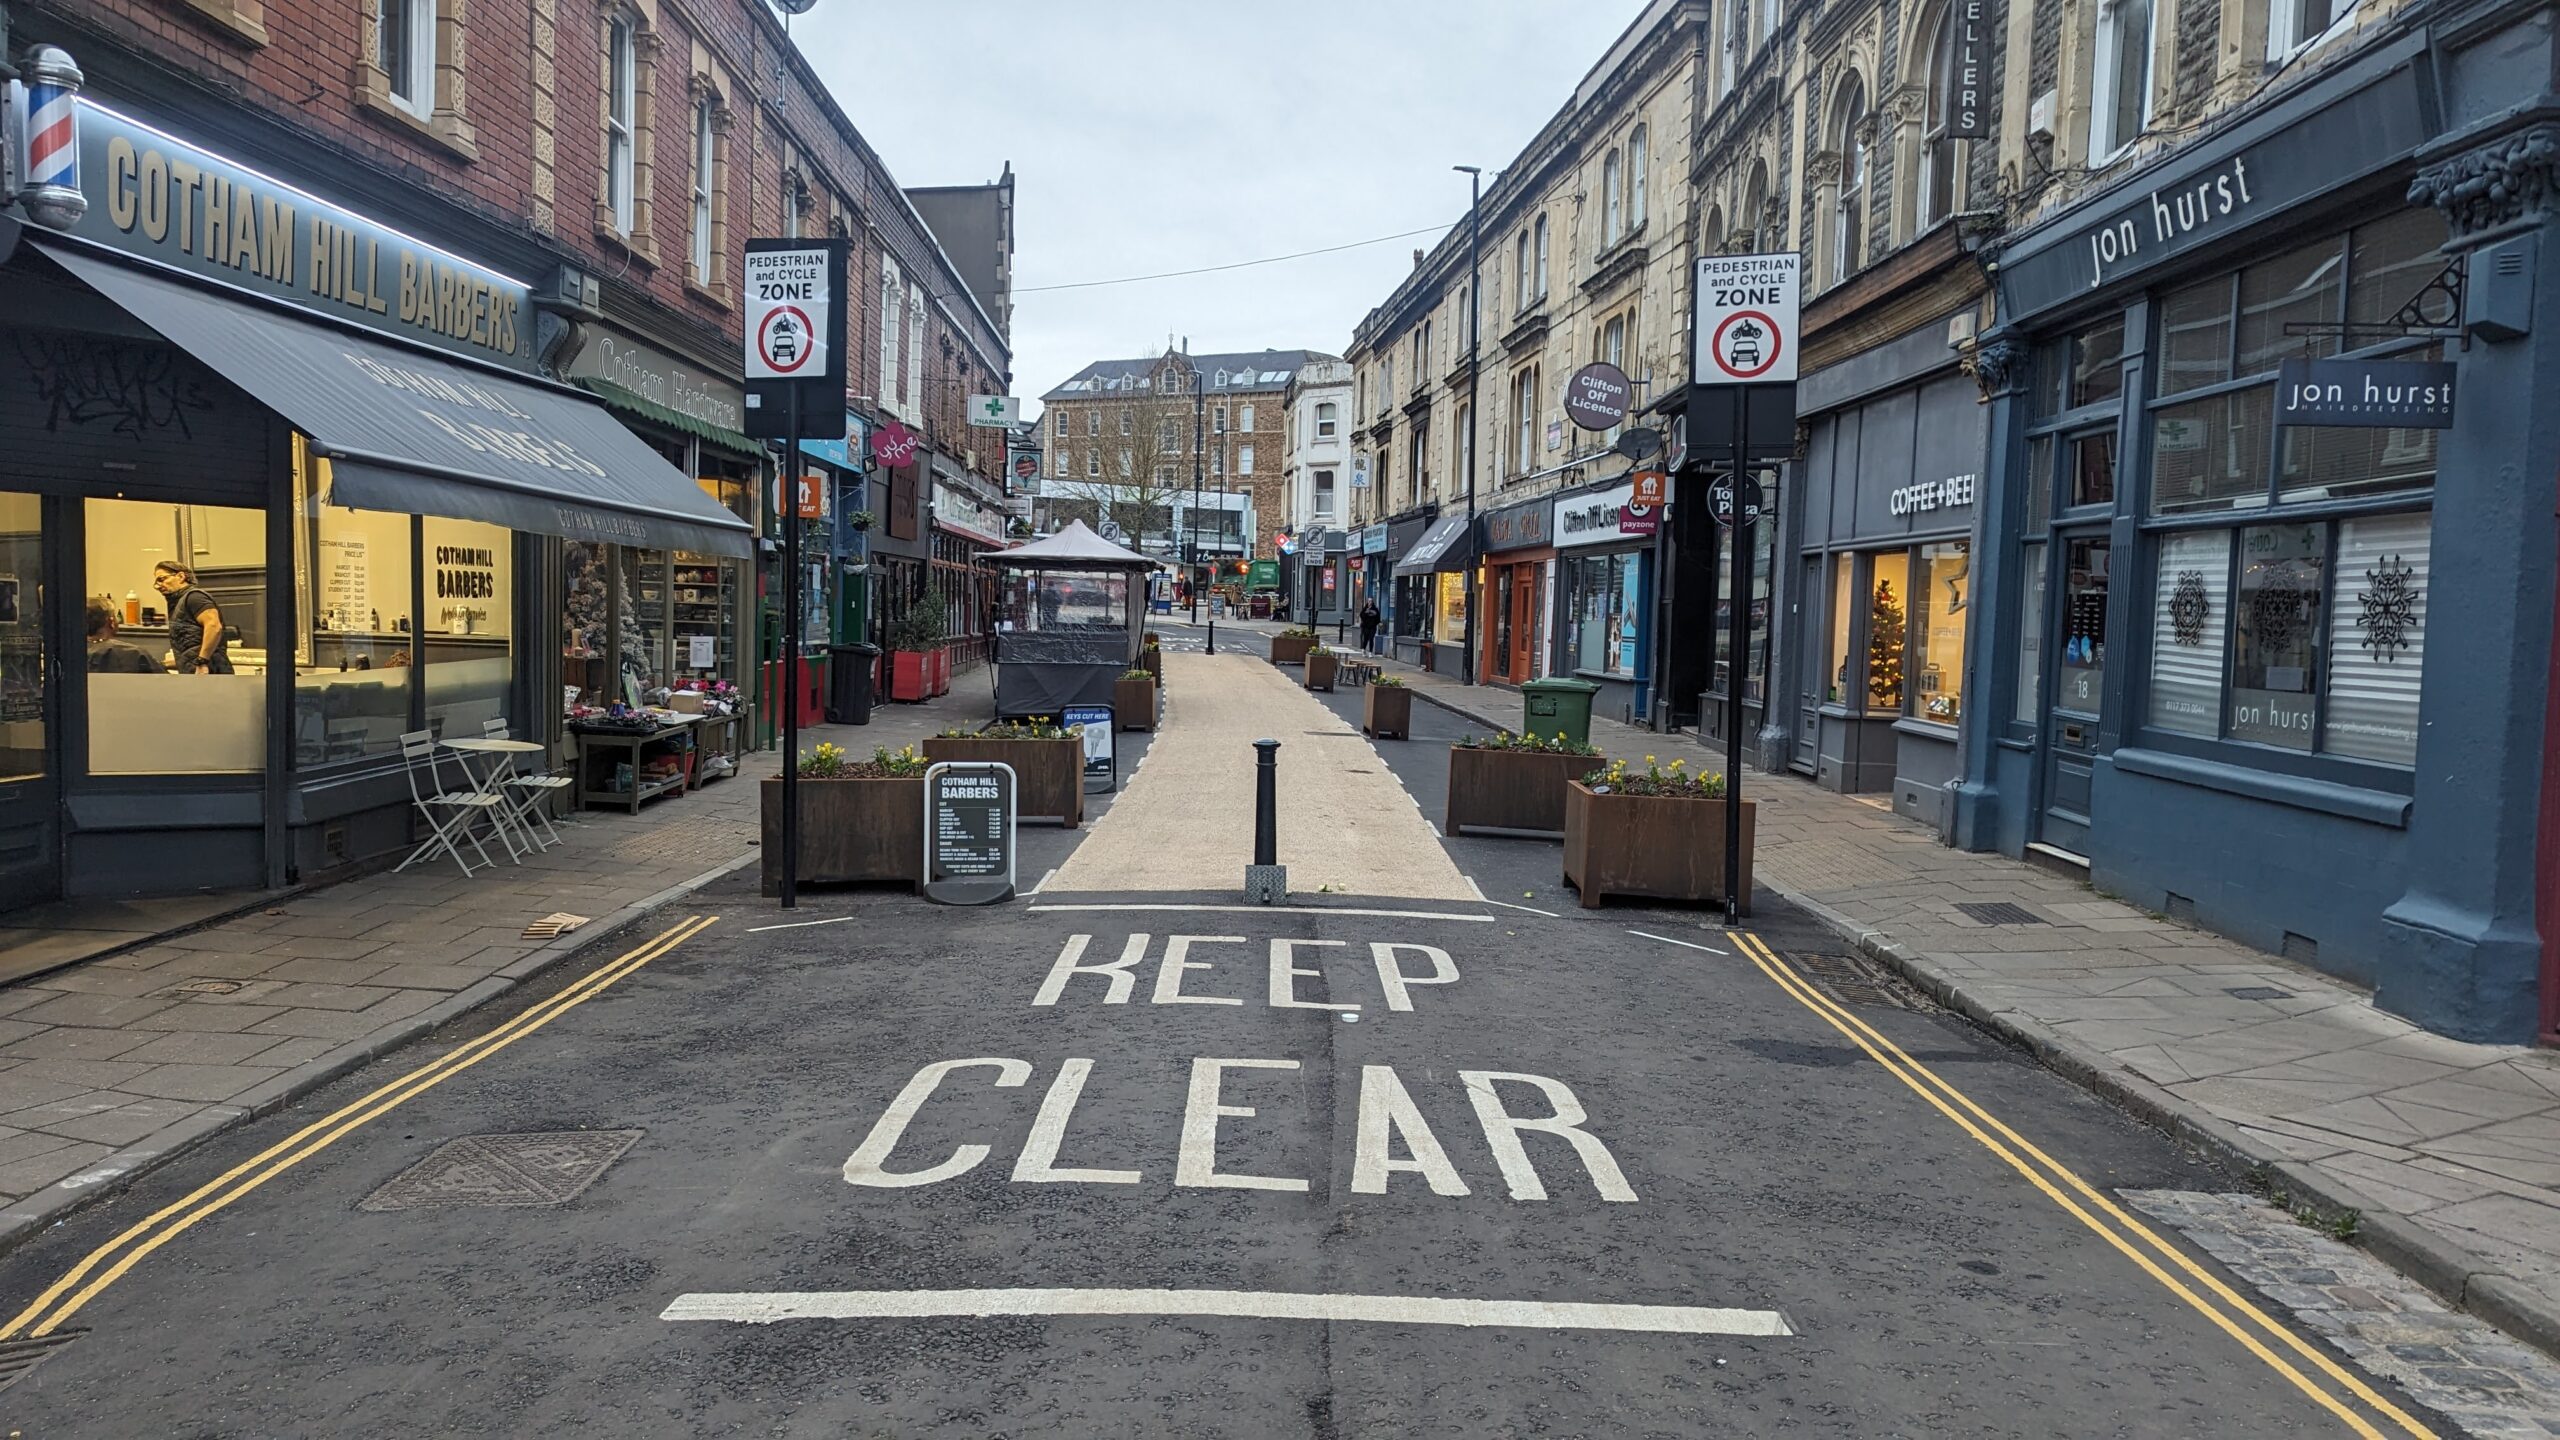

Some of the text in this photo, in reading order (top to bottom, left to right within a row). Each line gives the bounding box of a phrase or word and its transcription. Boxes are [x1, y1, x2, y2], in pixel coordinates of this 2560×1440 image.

[2091, 156, 2254, 288] jon hurst
[108, 136, 518, 356] COTHAM HILL BARBERS
[749, 254, 824, 268] PEDESTRIAN
[1703, 258, 1795, 274] PEDESTRIAN
[755, 268, 817, 281] and CYCLE
[1711, 272, 1786, 287] and CYCLE
[759, 282, 813, 301] ZONE
[1715, 287, 1781, 307] ZONE
[344, 353, 532, 421] COTHAM HILL
[598, 337, 737, 430] Cotham Hardware
[1581, 376, 1623, 394] Clifton
[2286, 374, 2451, 411] jon hurst
[1587, 389, 1609, 403] Off
[1572, 396, 1622, 417] Licence
[2301, 405, 2449, 414] HAIRDRESSING
[974, 418, 1014, 427] PHARMACY
[802, 505, 816, 513] EAT
[1598, 502, 1620, 528] Licen
[1719, 501, 1758, 515] Piza
[559, 508, 594, 530] COTHAM
[1622, 521, 1655, 530] payzone
[436, 545, 494, 567] COTHAM HILL
[437, 569, 493, 598] BARBERS
[2078, 680, 2089, 699] 18
[2231, 705, 2260, 731] jon
[941, 777, 999, 786] COTHAM HILL
[941, 787, 999, 799] BARBERS
[1031, 933, 1461, 1012] KEEP
[843, 1057, 1640, 1202] CLEAR
